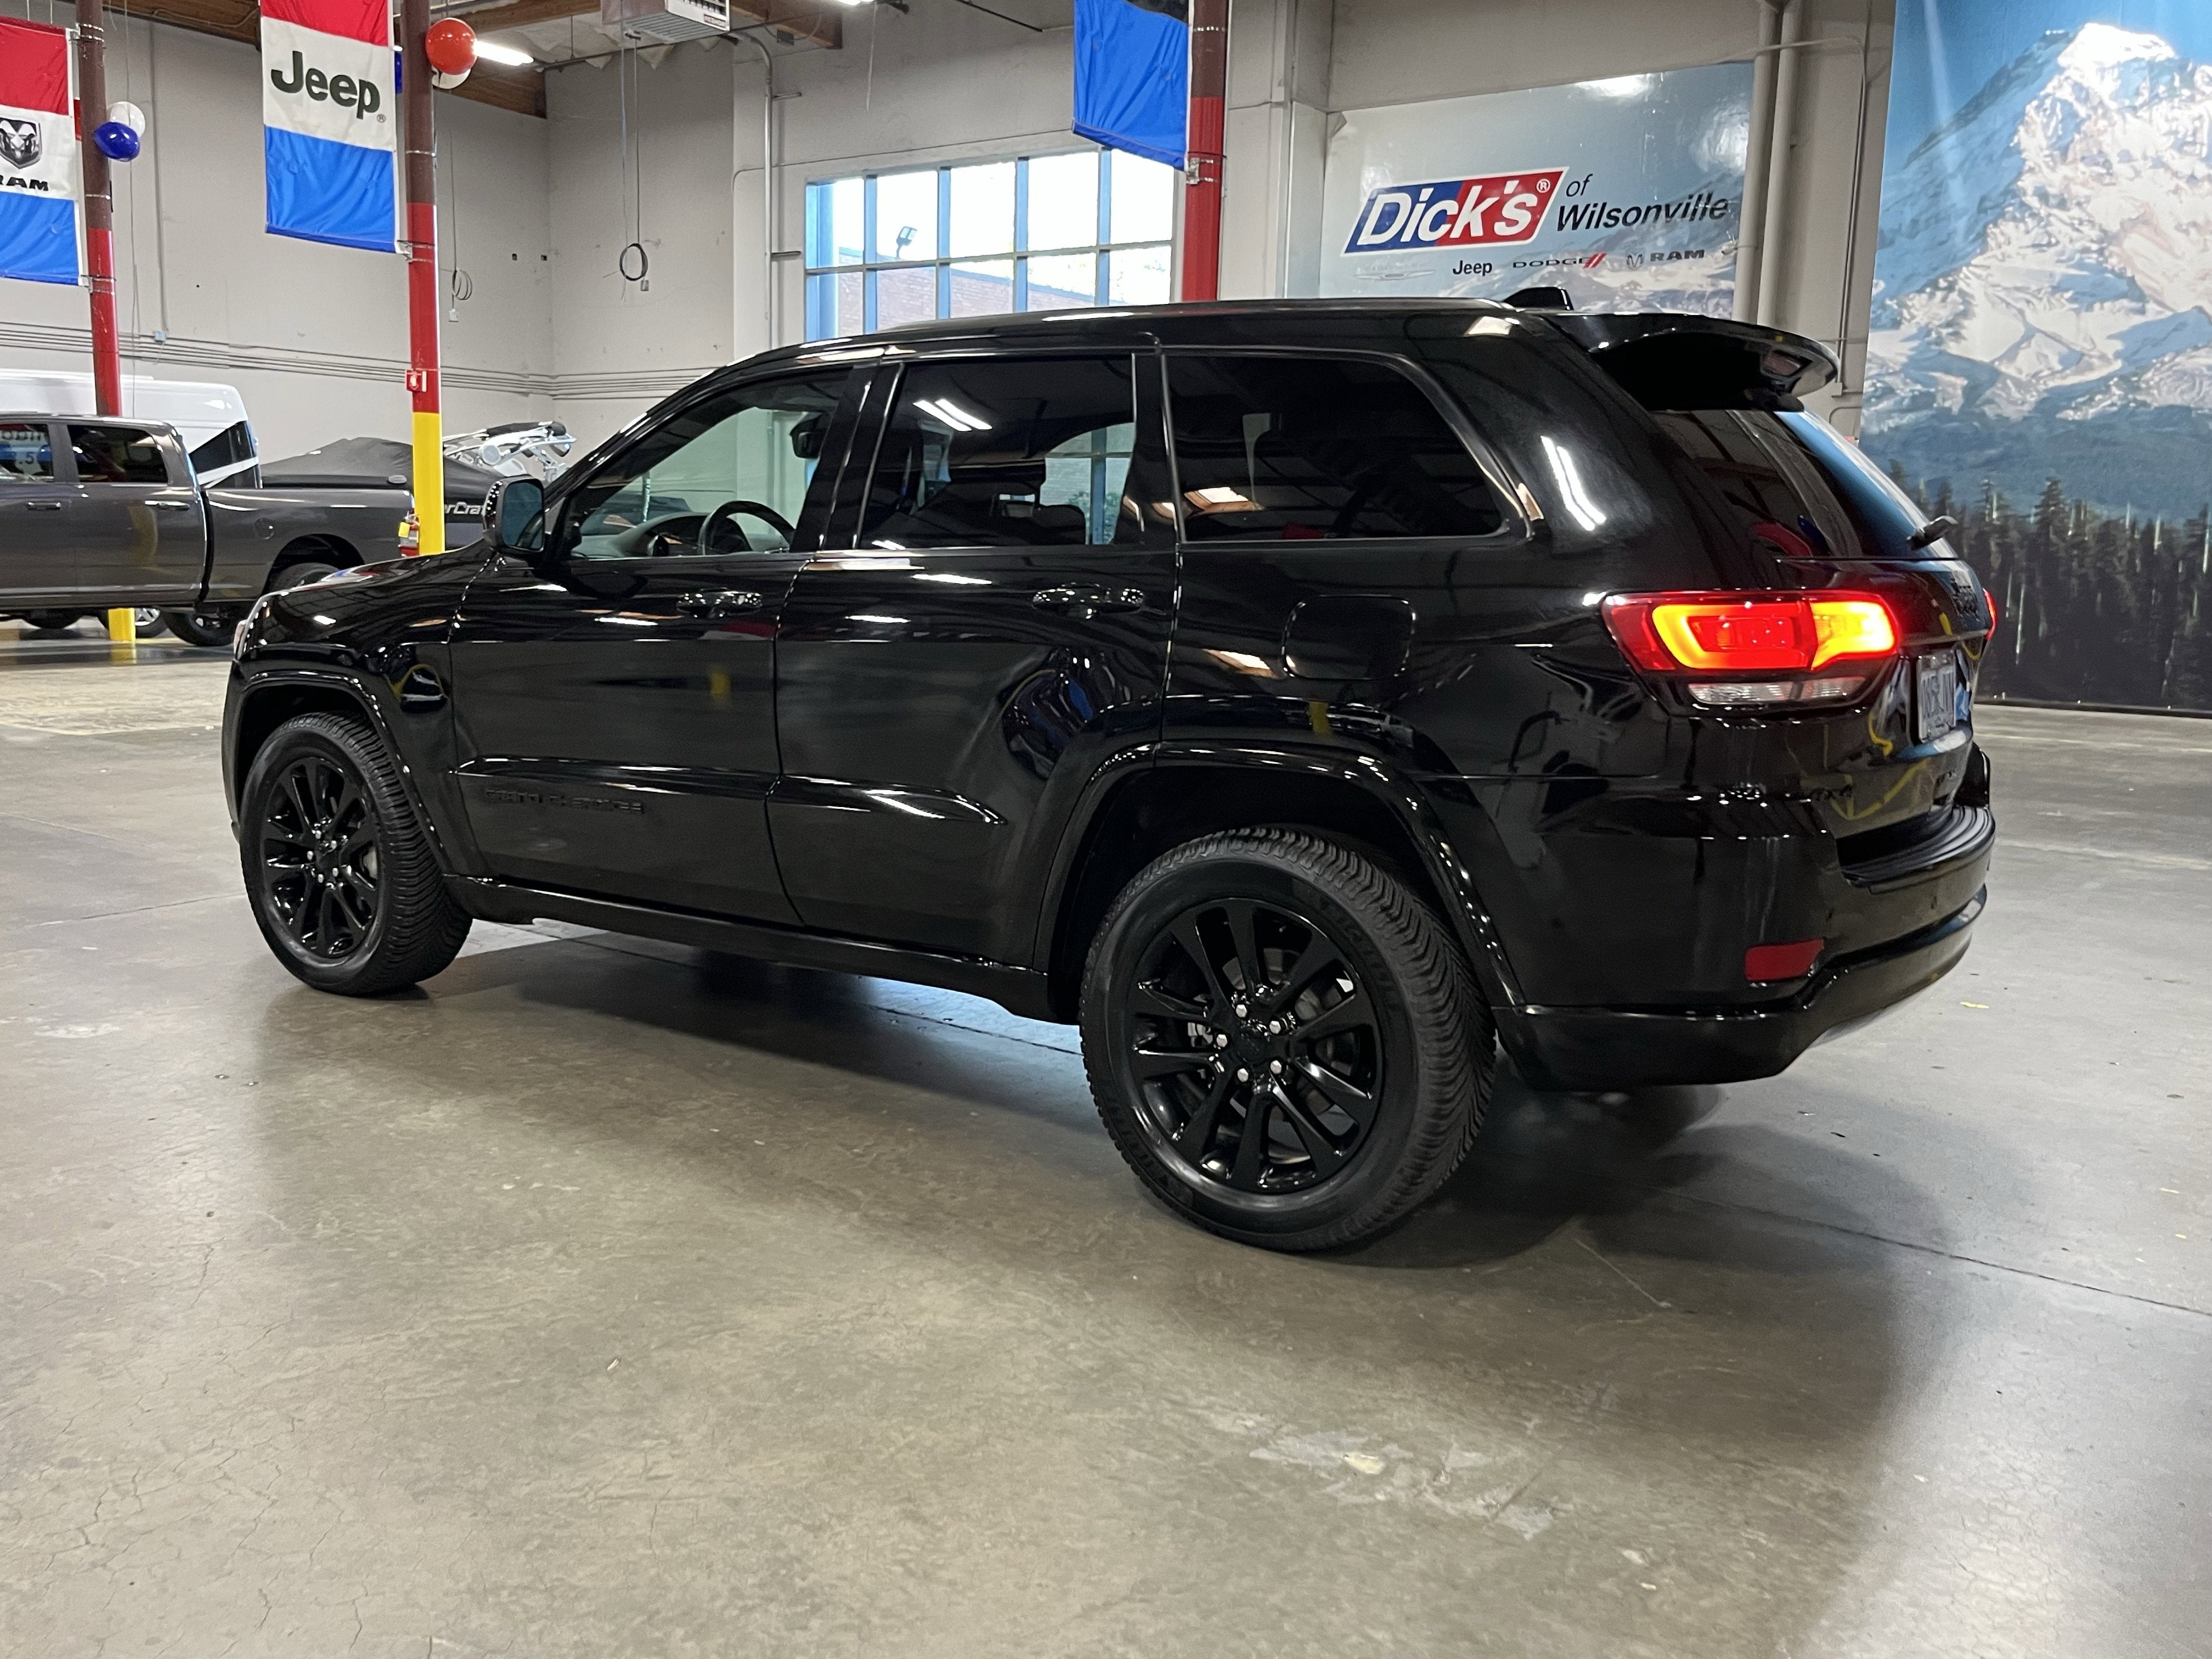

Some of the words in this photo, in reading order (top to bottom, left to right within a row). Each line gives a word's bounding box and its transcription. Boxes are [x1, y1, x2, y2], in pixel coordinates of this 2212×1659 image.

[271, 50, 380, 120] Jeep
[0, 174, 48, 191] AM
[1566, 173, 1593, 197] of
[1557, 191, 1728, 232] Wilsonville
[1513, 257, 1591, 268] DODGE
[1650, 250, 1705, 262] RAM
[1453, 260, 1492, 276] Jeep
